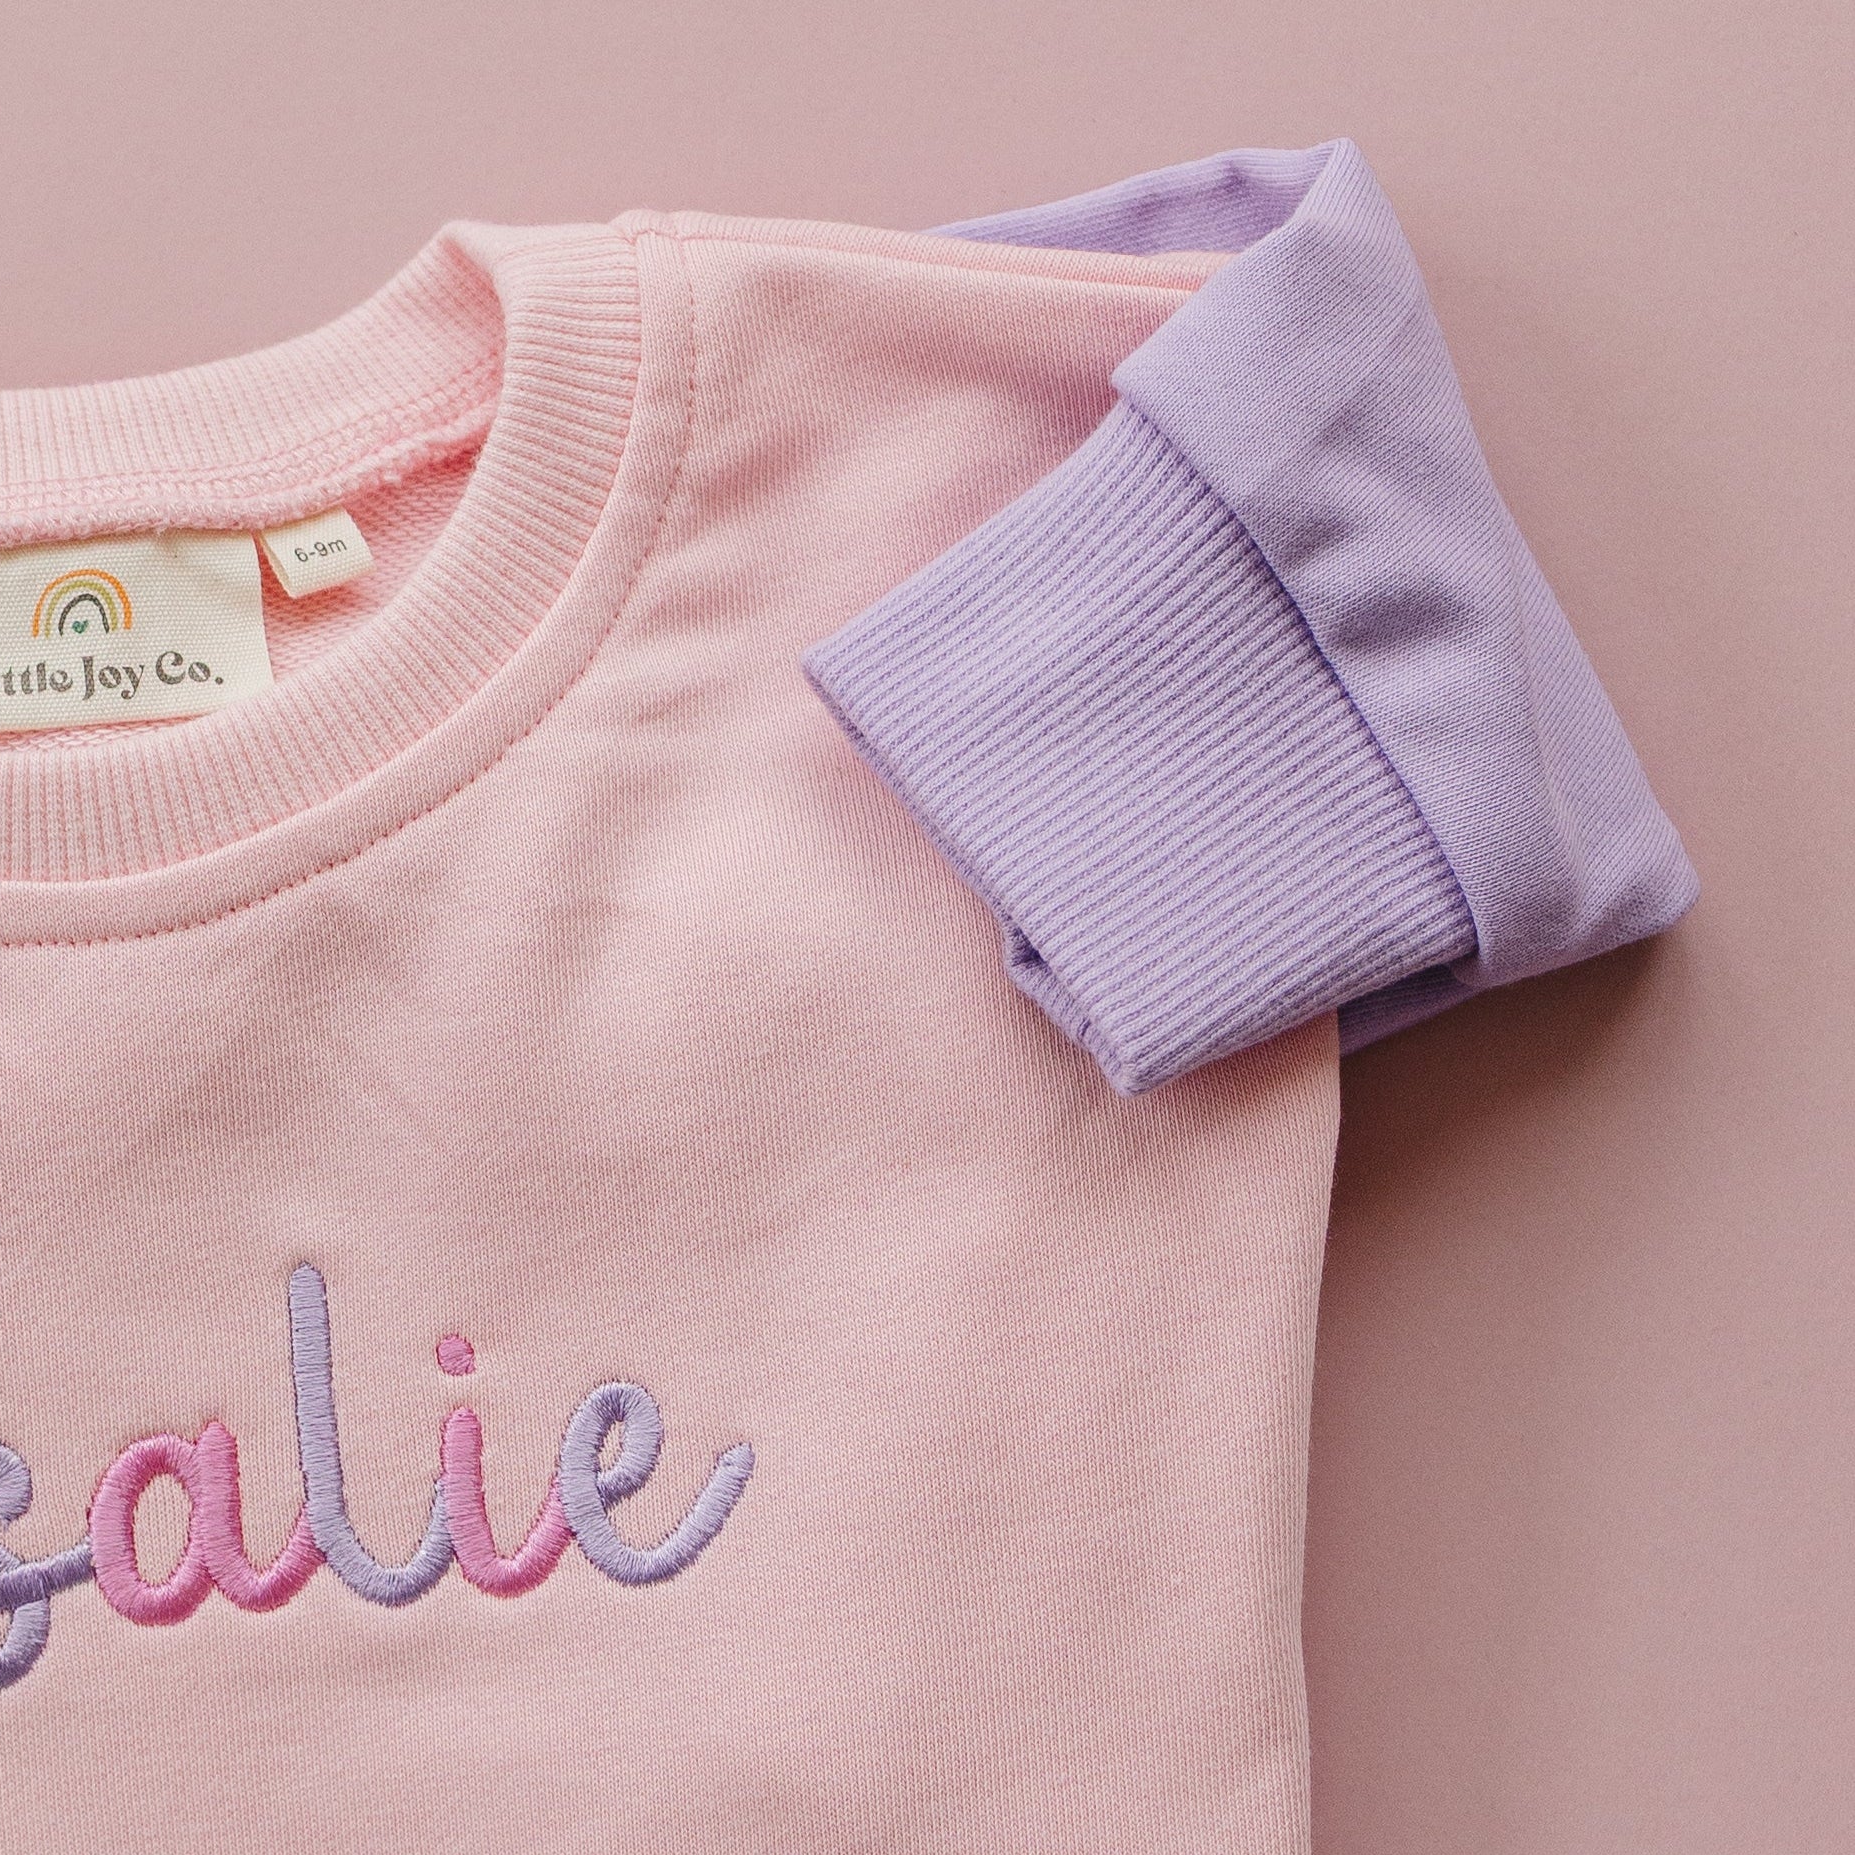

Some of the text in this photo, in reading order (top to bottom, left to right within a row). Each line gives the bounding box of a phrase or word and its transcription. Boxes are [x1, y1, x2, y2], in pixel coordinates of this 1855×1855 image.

[293, 539, 348, 563] 6-9m
[81, 655, 146, 701] Joy
[155, 649, 225, 687] Co.
